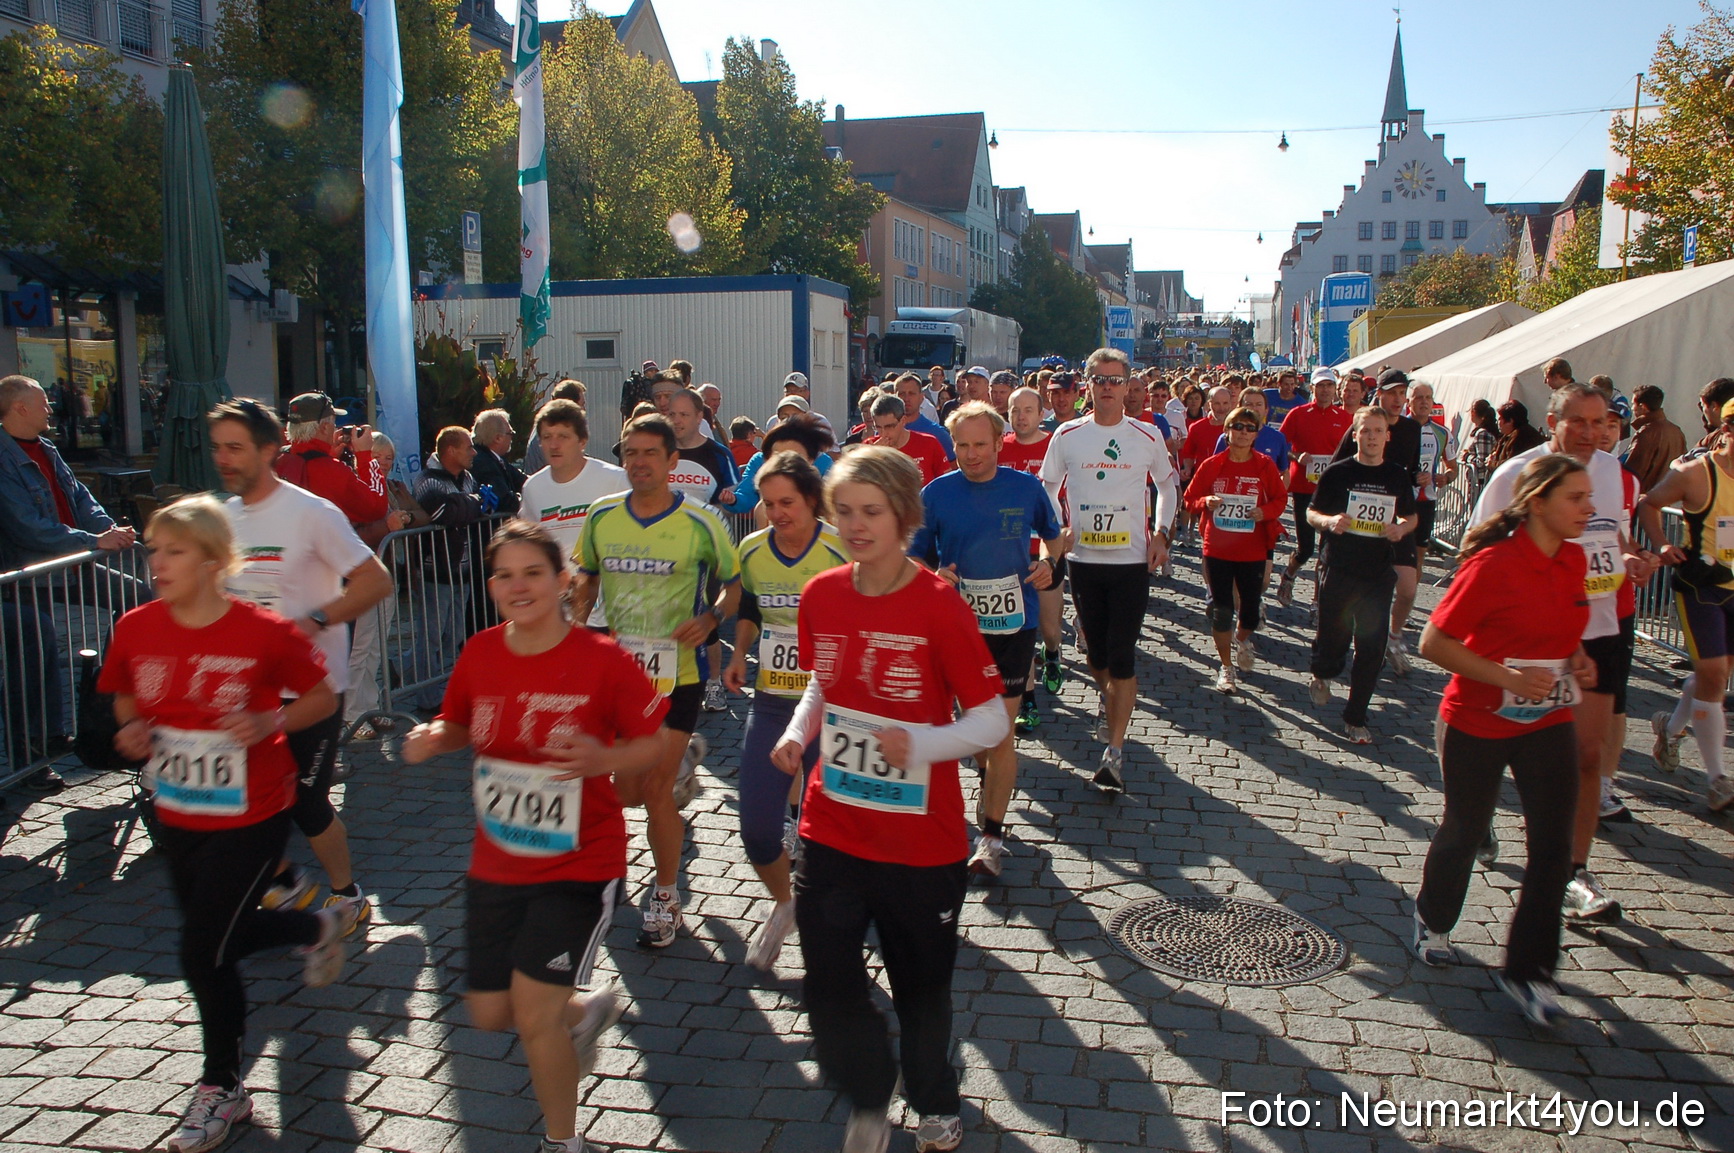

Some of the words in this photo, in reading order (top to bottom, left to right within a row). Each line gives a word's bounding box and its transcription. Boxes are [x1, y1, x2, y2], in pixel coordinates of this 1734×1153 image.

[466, 216, 477, 245] P
[1686, 236, 1694, 258] P
[1332, 281, 1367, 301] maxi
[1110, 312, 1127, 324] axi
[668, 474, 710, 485] BOSCH
[1219, 504, 1251, 519] 2735
[1357, 504, 1385, 522] 293
[1093, 514, 1114, 531] 87
[1356, 521, 1382, 531] Martin
[1091, 533, 1116, 543] Klaus
[604, 544, 651, 555] TEAM
[602, 556, 677, 576] BOCK
[1590, 551, 1614, 574] 43
[760, 582, 798, 591] TEAM
[966, 592, 1016, 616] 2526
[978, 617, 1008, 627] Frank
[770, 671, 812, 689] Brigitt
[831, 732, 907, 779] 213
[156, 749, 230, 787] 2016
[838, 772, 902, 801] Angela
[485, 782, 566, 829] 2794
